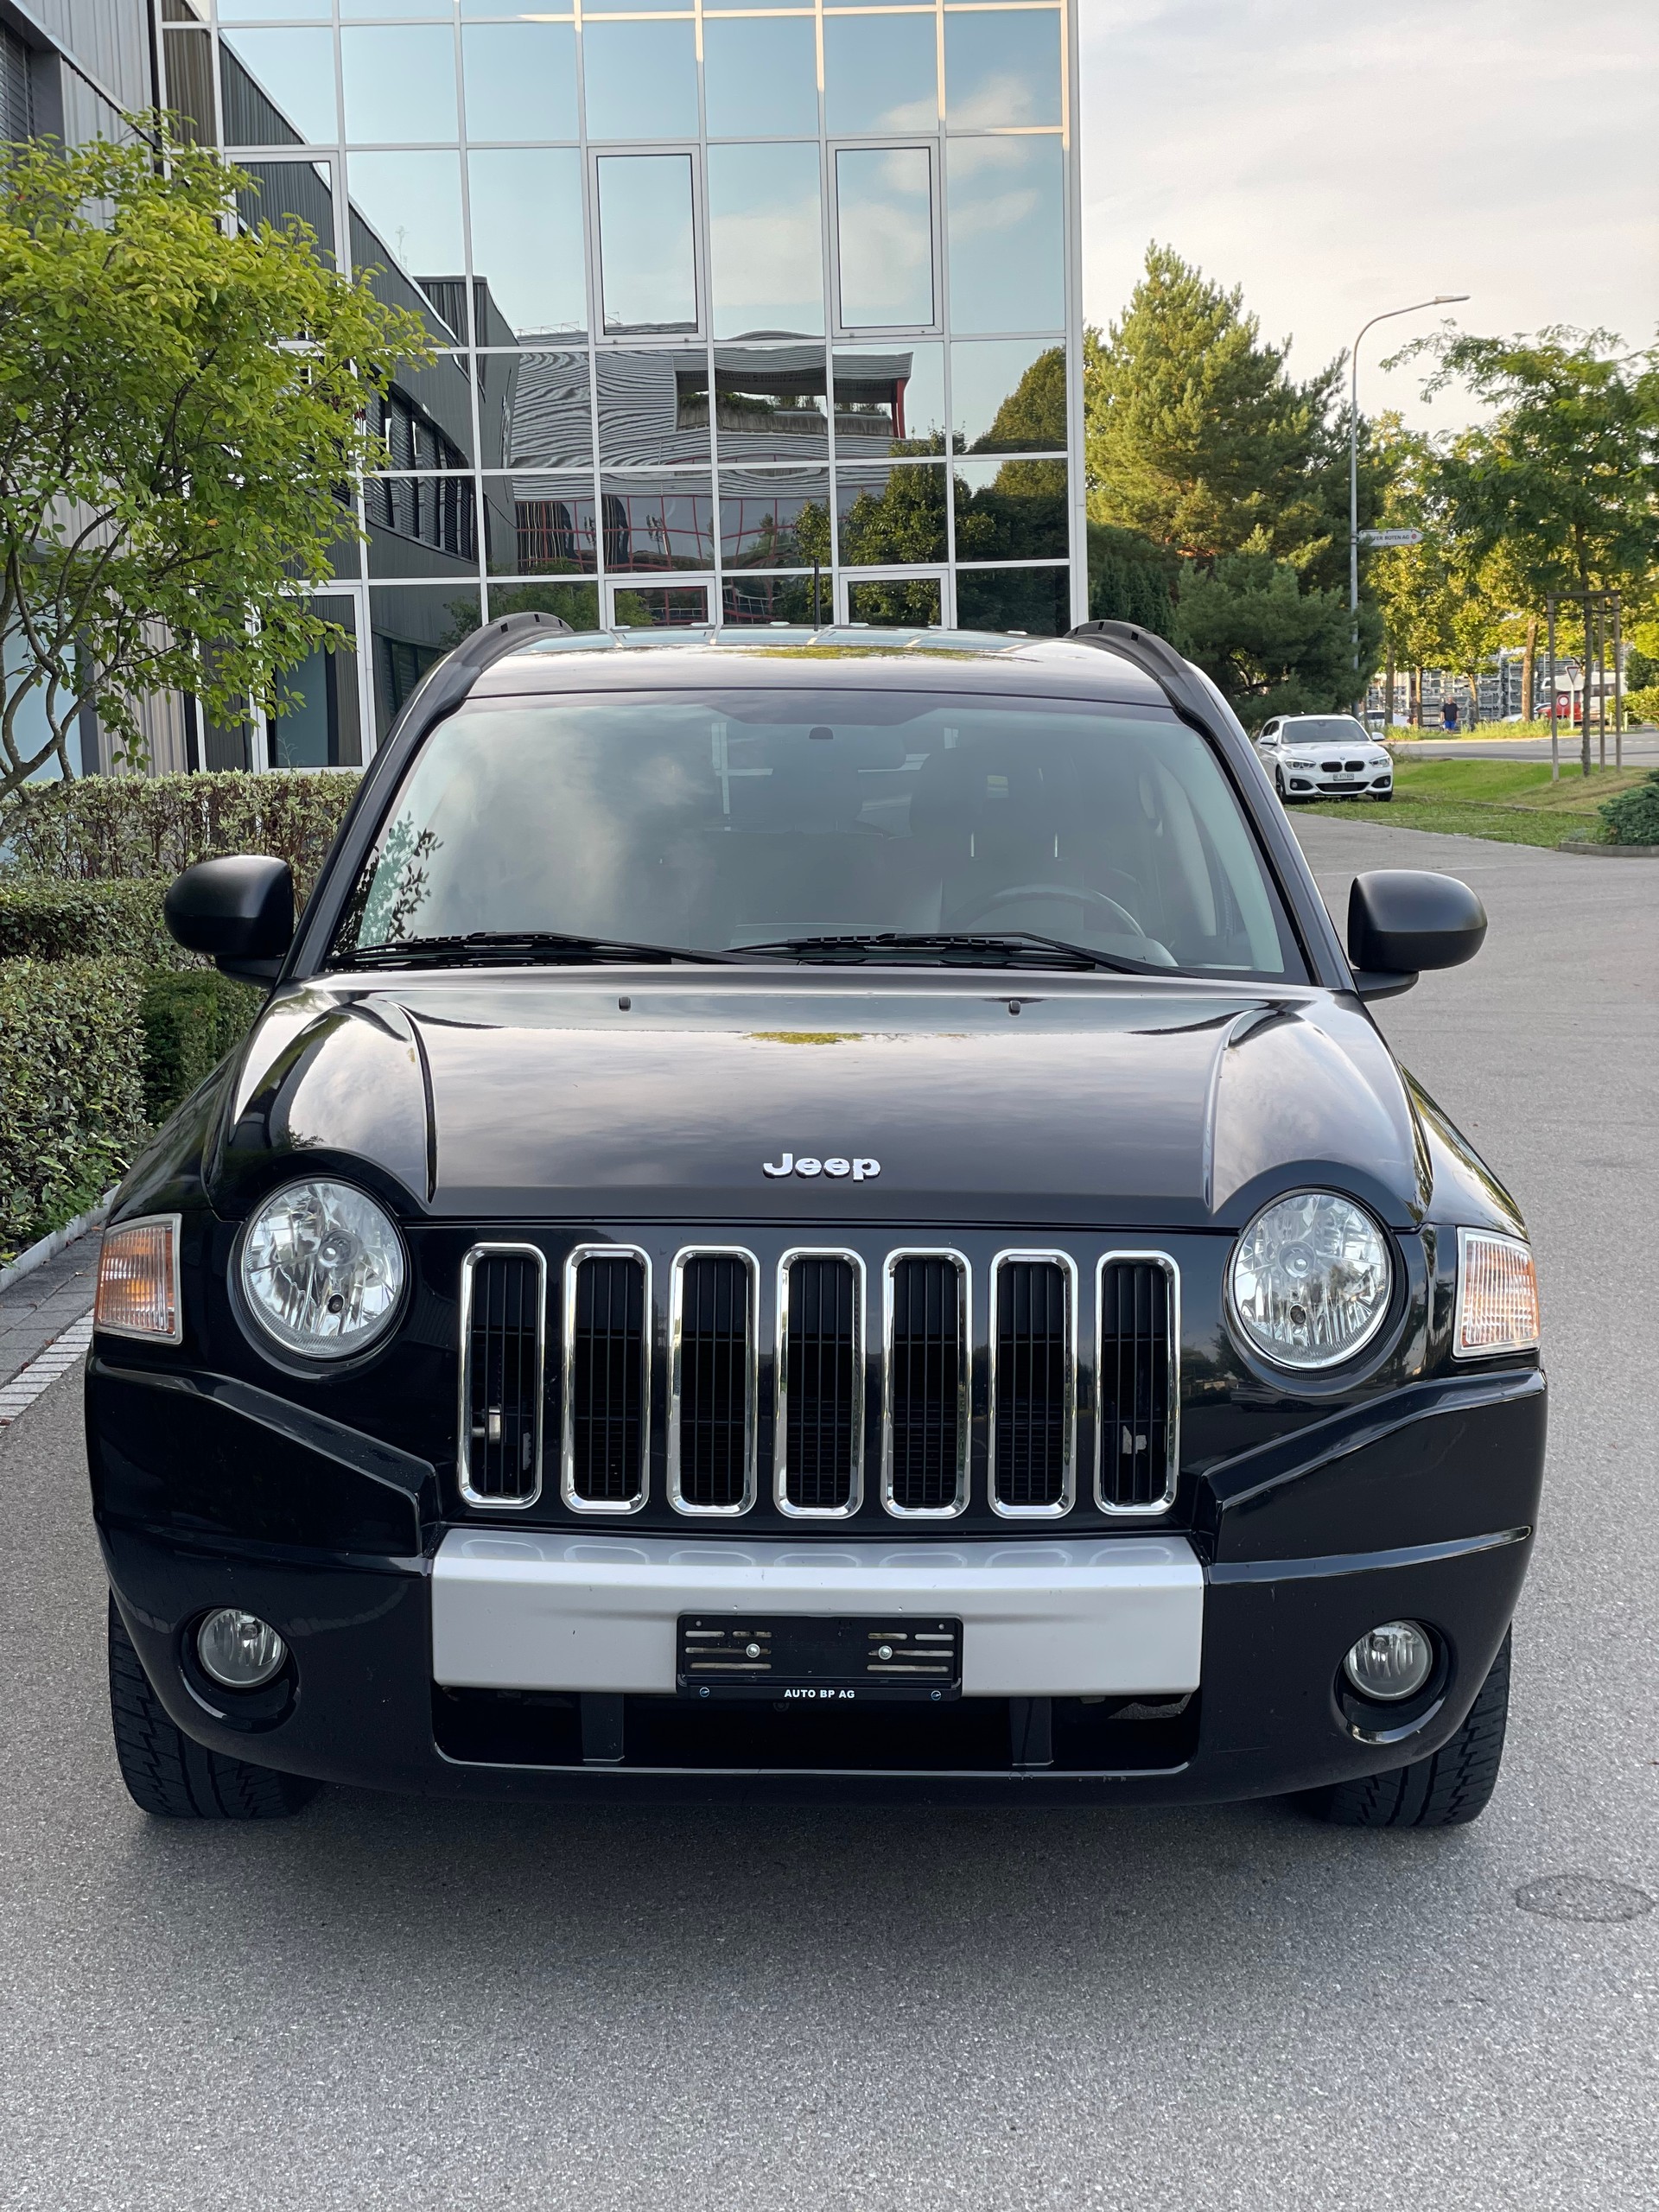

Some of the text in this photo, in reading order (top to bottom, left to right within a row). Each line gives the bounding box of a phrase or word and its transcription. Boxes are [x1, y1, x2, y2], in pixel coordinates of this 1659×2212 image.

[763, 1153, 880, 1182] Jeep
[784, 1689, 855, 1699] AUTO BP AG
